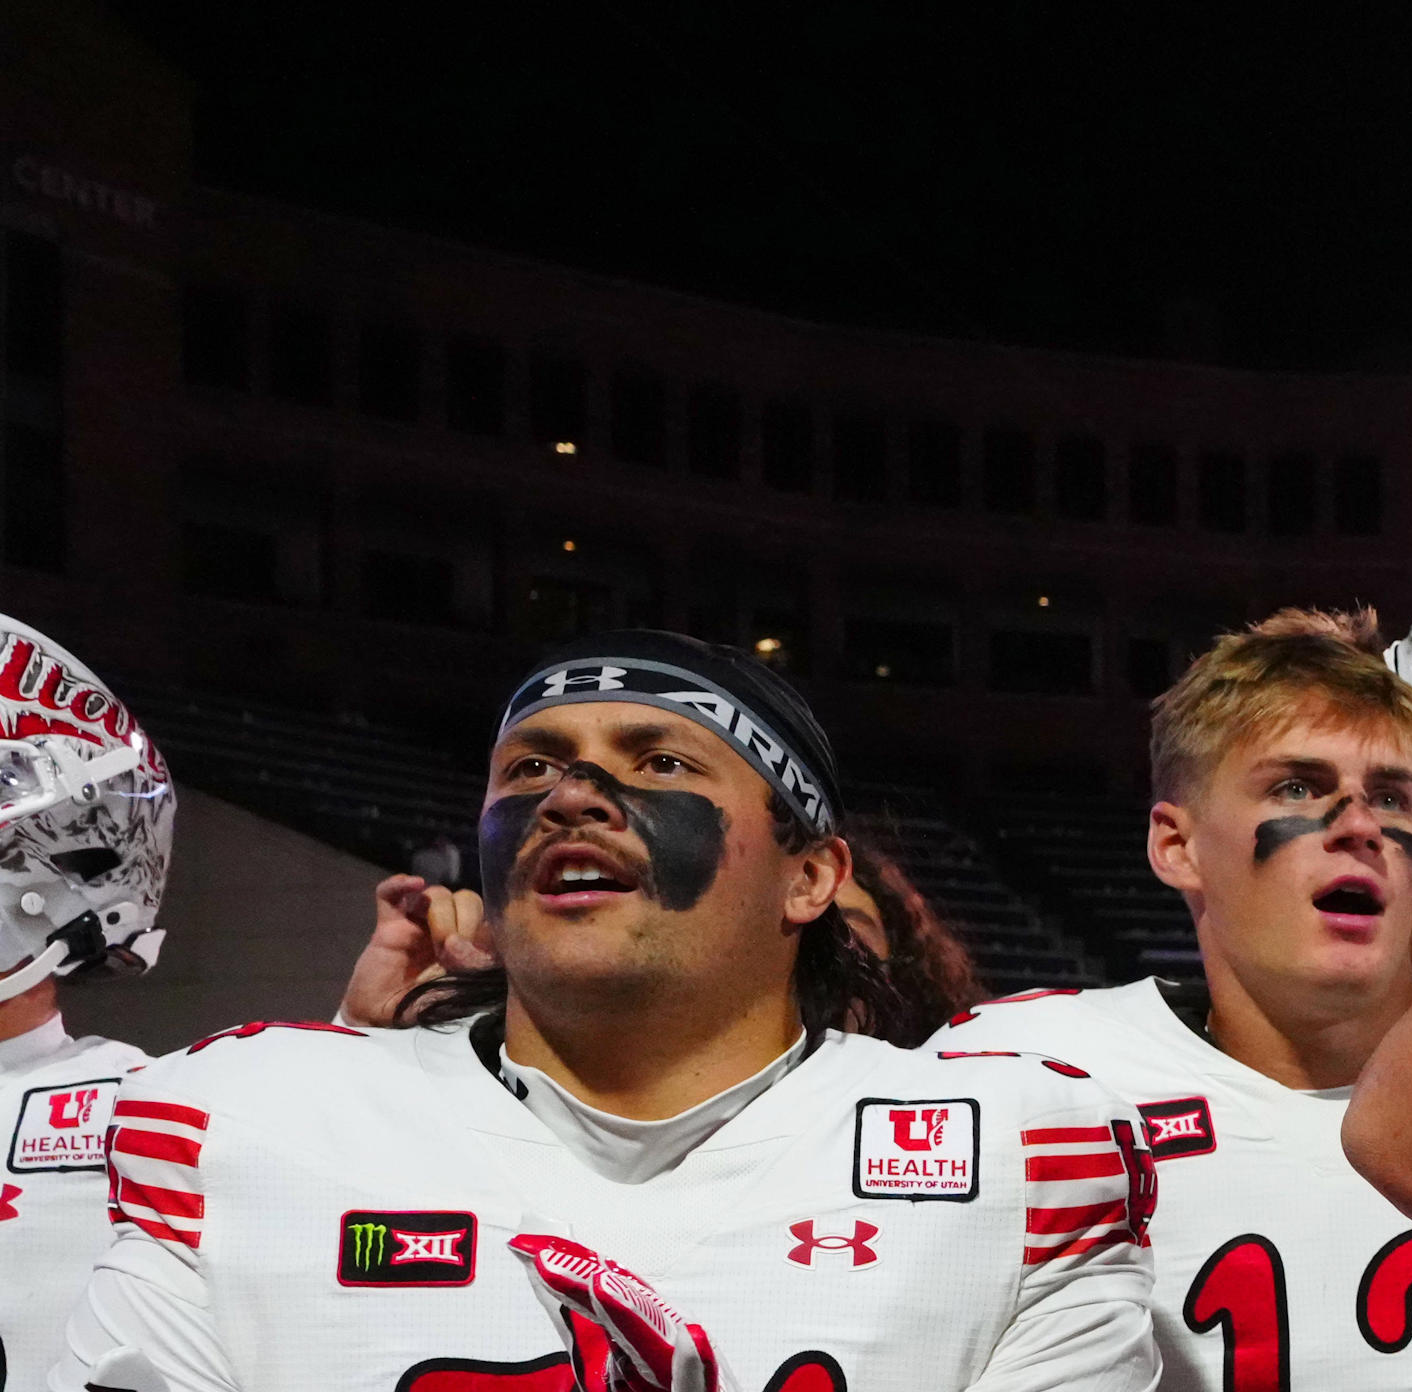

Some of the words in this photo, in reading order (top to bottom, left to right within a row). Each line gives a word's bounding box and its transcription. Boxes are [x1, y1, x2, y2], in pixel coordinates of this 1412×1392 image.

[1151, 1112, 1204, 1142] XII
[87, 1153, 105, 1161] UTA
[867, 1158, 967, 1177] HEALTH
[865, 1179, 923, 1188] UNIVERSITY
[925, 1181, 938, 1189] OF
[941, 1181, 967, 1189] UTAH
[394, 1232, 462, 1262] XII
